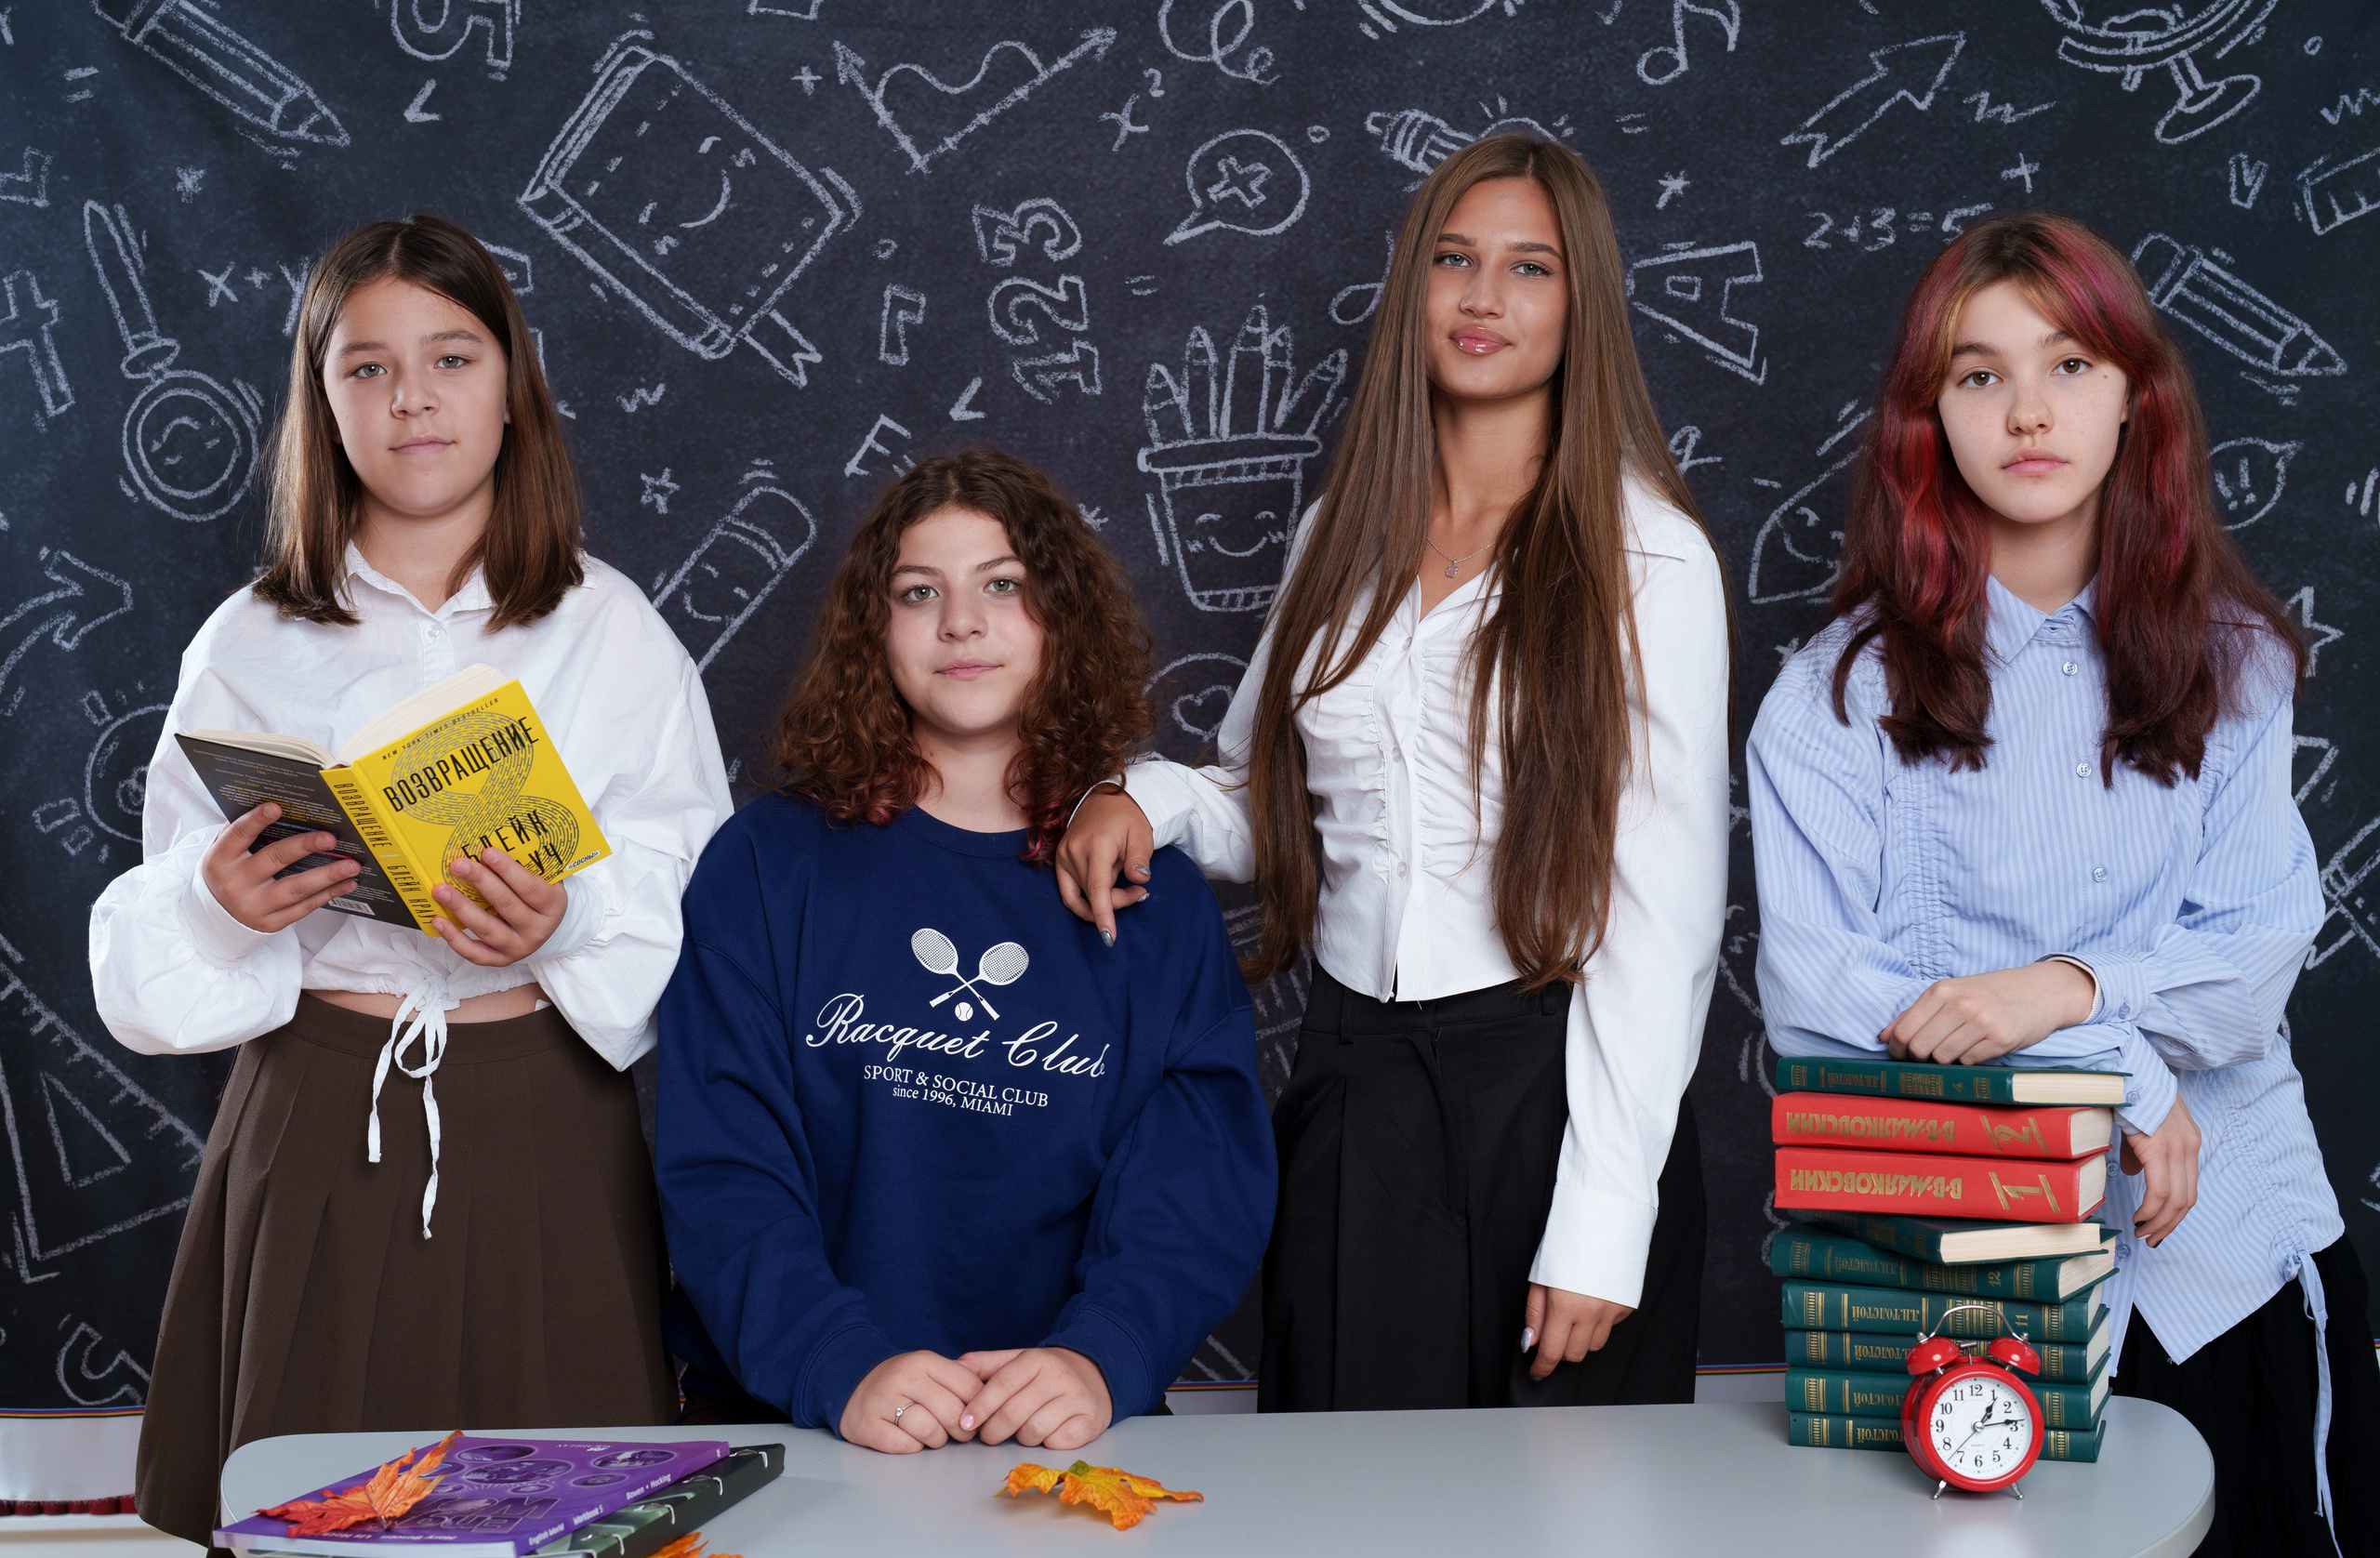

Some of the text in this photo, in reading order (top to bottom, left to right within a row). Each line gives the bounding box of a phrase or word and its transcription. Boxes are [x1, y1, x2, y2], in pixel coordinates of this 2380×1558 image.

[382, 697, 500, 760] NEW YORK TIMES BESTSELLER
[382, 716, 539, 812] ВОЗВРАЩЕНИЕ
[334, 783, 392, 848] ВОЗВРАЩЕНИЕ
[387, 865, 421, 892] БЛЕЙК
[805, 993, 1110, 1078] Racquet Club
[864, 1064, 1049, 1108] SPORT & SOCIAL CLUB
[892, 1085, 1013, 1116] since 1996, MIAMI
[1988, 1270, 2002, 1288] 12
[2015, 1313, 2029, 1327] 11
[1953, 1389, 1964, 1401] 11
[1969, 1384, 1983, 1396] 12
[1990, 1389, 1996, 1401] 1
[1940, 1402, 1952, 1415] 10
[2003, 1401, 2012, 1413] 2
[1936, 1419, 1944, 1433] 9
[2010, 1419, 2018, 1432] 3
[1942, 1437, 1951, 1450] 8
[2003, 1437, 2012, 1449] 4
[1957, 1451, 1964, 1463] 7
[1974, 1455, 1983, 1467] 6
[1992, 1450, 2001, 1462] 5
[528, 1473, 672, 1546] English World Workbook 5 Bowen Hocking
